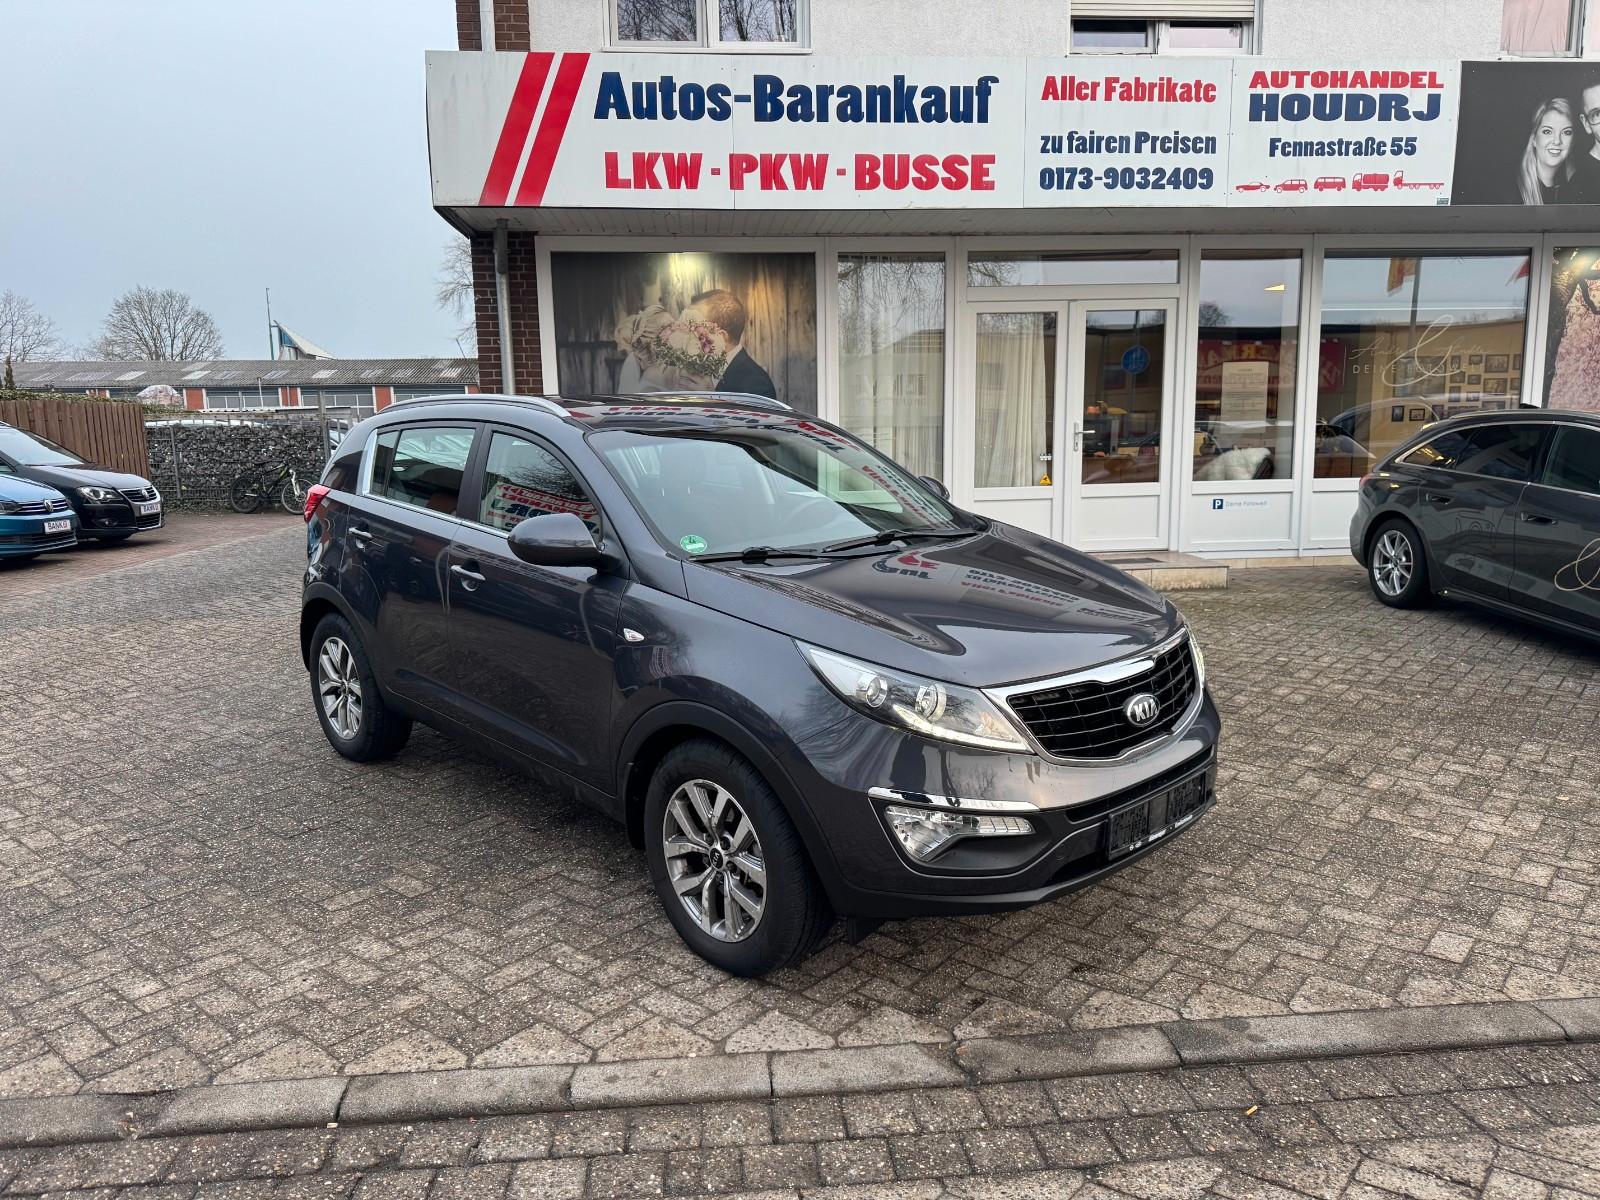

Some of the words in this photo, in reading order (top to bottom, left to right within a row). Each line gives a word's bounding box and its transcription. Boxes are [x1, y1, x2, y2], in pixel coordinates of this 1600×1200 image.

[1041, 76, 1100, 102] Aller
[1103, 77, 1217, 103] Fabrikate
[1249, 70, 1444, 89] AUTOHANDEL
[594, 72, 1000, 123] Autos-Barankauf
[1249, 93, 1442, 122] HOUDRJ
[1040, 134, 1062, 154] zu
[1066, 130, 1131, 154] fairen
[1134, 131, 1217, 154] Preisen
[1269, 137, 1387, 158] Fennastraße
[1390, 136, 1417, 156] 55
[604, 152, 703, 190] LKW
[729, 153, 829, 190] PKW
[854, 154, 996, 191] BUSSE
[1039, 167, 1214, 191] 0173-9032409
[1133, 698, 1158, 722] KIA
